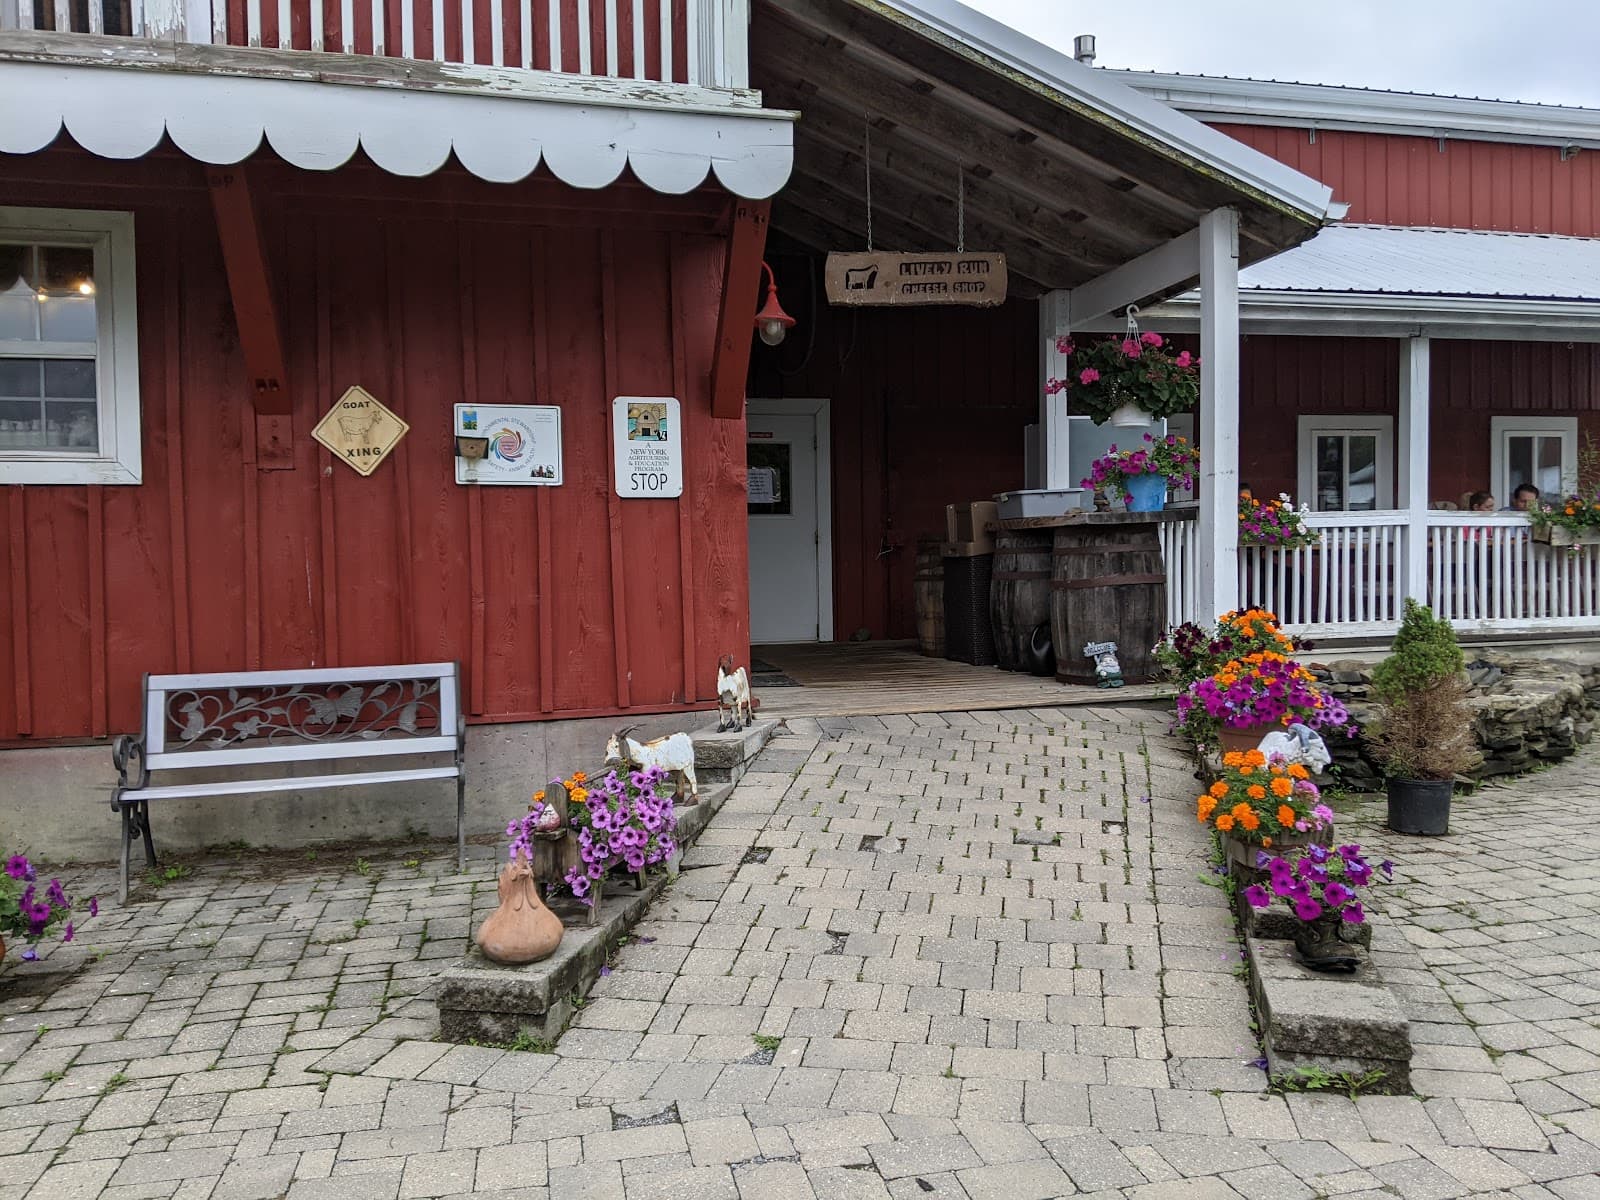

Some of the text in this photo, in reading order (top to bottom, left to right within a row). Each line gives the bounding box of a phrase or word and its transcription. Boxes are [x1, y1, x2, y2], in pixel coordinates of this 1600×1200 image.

[901, 261, 989, 276] LIVELY RUN
[902, 282, 985, 294] CHEESE SHOP
[342, 401, 370, 409] GOAT
[347, 447, 381, 458] XING
[631, 473, 668, 491] STOP
